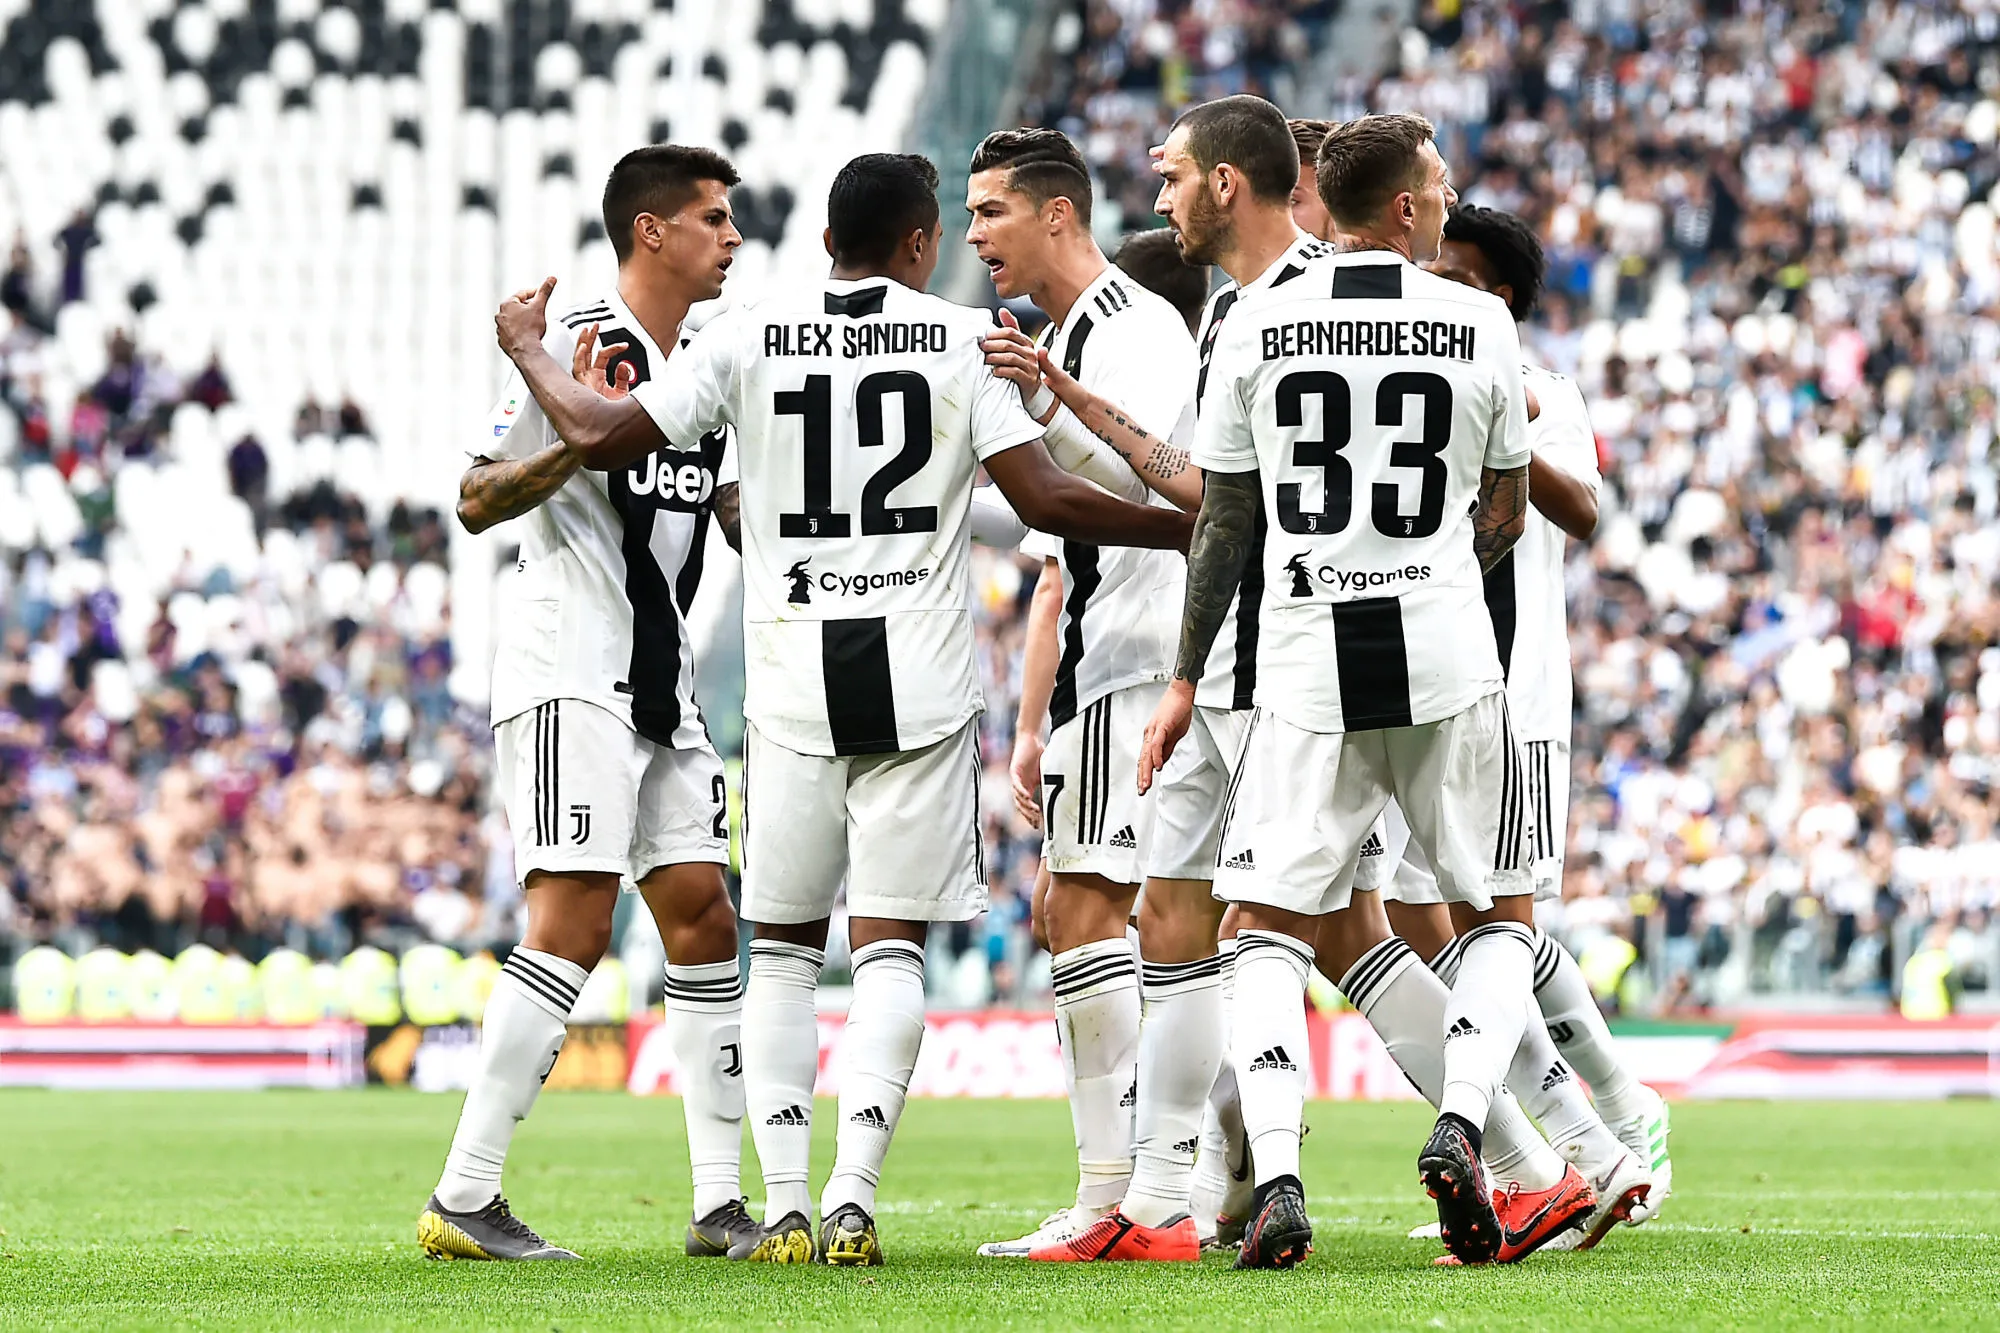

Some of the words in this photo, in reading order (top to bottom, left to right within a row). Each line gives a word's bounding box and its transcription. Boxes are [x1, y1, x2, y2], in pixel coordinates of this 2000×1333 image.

[764, 323, 833, 358] ALEX
[842, 323, 947, 359] SANDRO
[1261, 320, 1476, 361] BERNARDESCHI
[773, 370, 939, 538] 12
[1275, 370, 1454, 539] 33
[819, 567, 930, 597] Cygames
[1317, 565, 1432, 591] Cygames
[1043, 774, 1065, 841] 7
[1225, 860, 1256, 871] adidas
[1249, 1060, 1297, 1072] adidas
[766, 1118, 809, 1126] adidas
[850, 1116, 890, 1132] adidas
